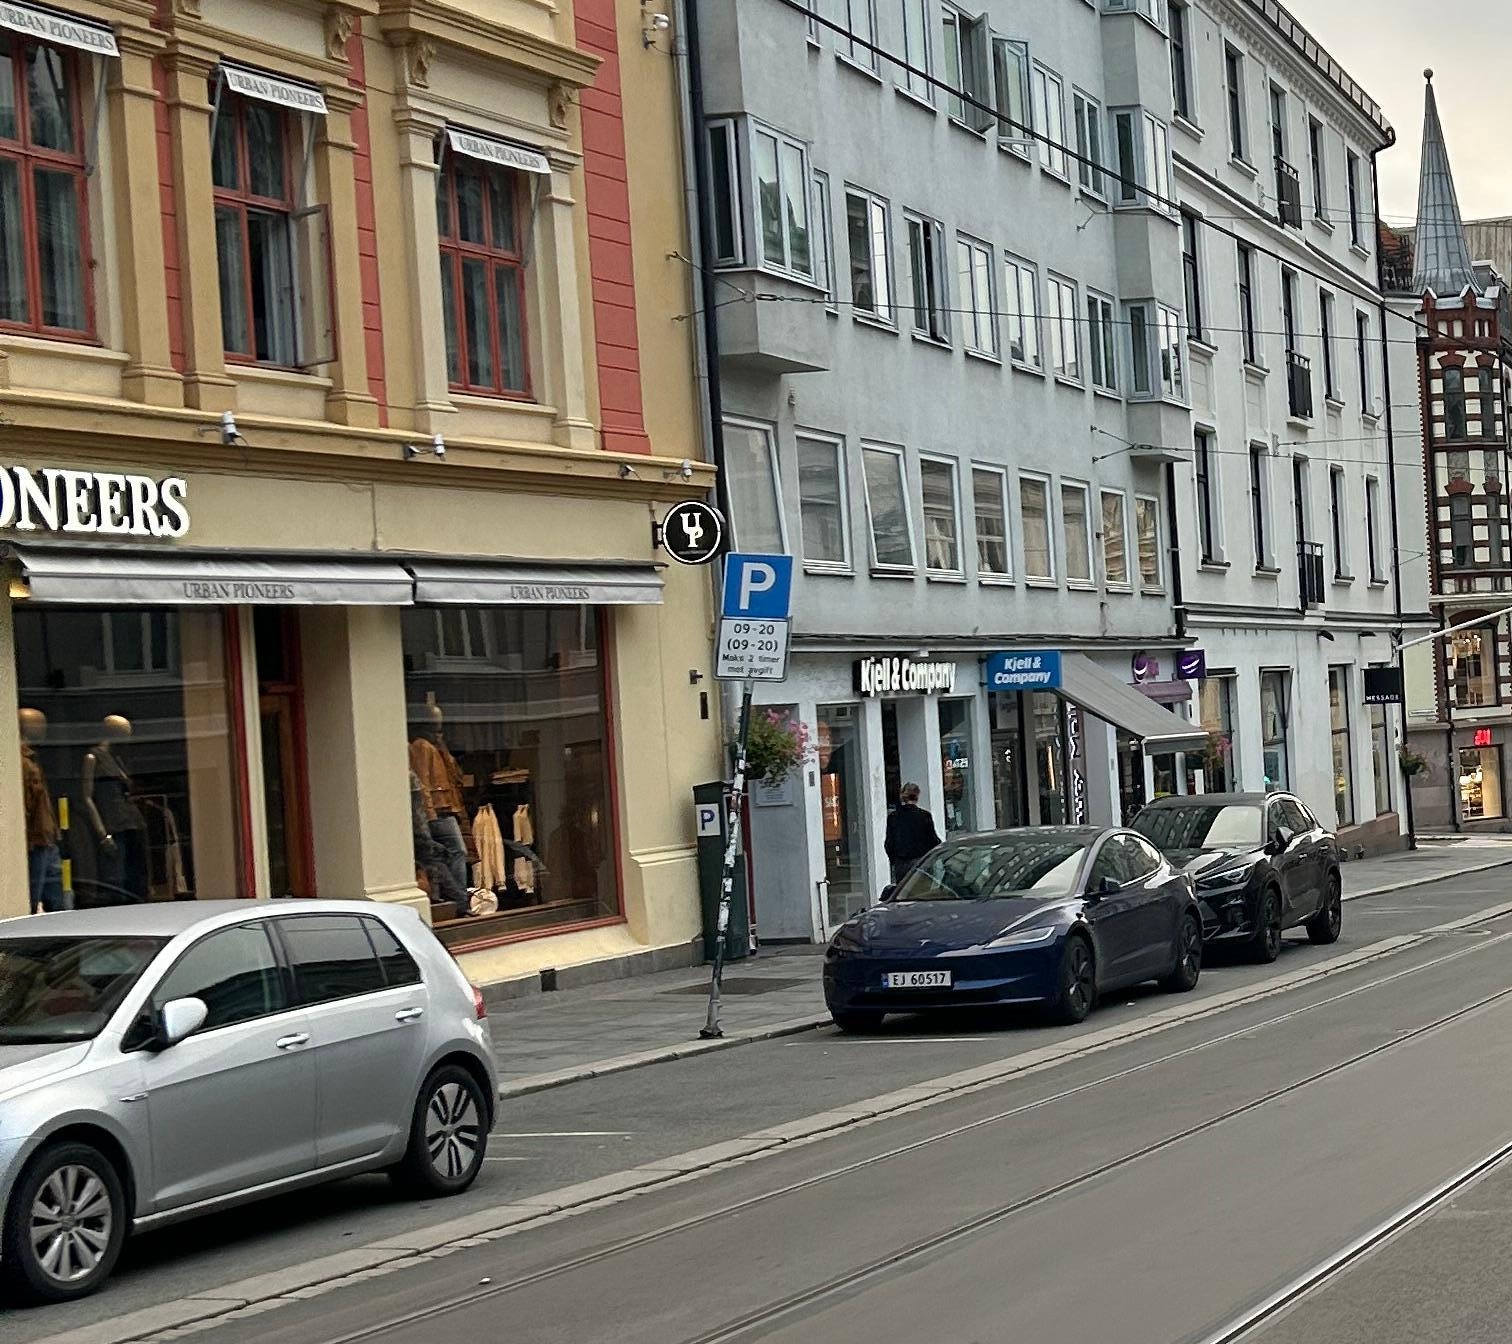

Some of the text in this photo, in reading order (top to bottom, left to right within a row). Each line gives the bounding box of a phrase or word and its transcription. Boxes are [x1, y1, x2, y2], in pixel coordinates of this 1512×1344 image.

[183, 582, 231, 599] URBAN
[739, 562, 776, 610] P
[1004, 657, 1032, 672] Kjell
[861, 656, 956, 697] Kjell & Company
[994, 672, 1051, 685] Company
[700, 809, 716, 831] P
[893, 973, 946, 986] EJ 60517
